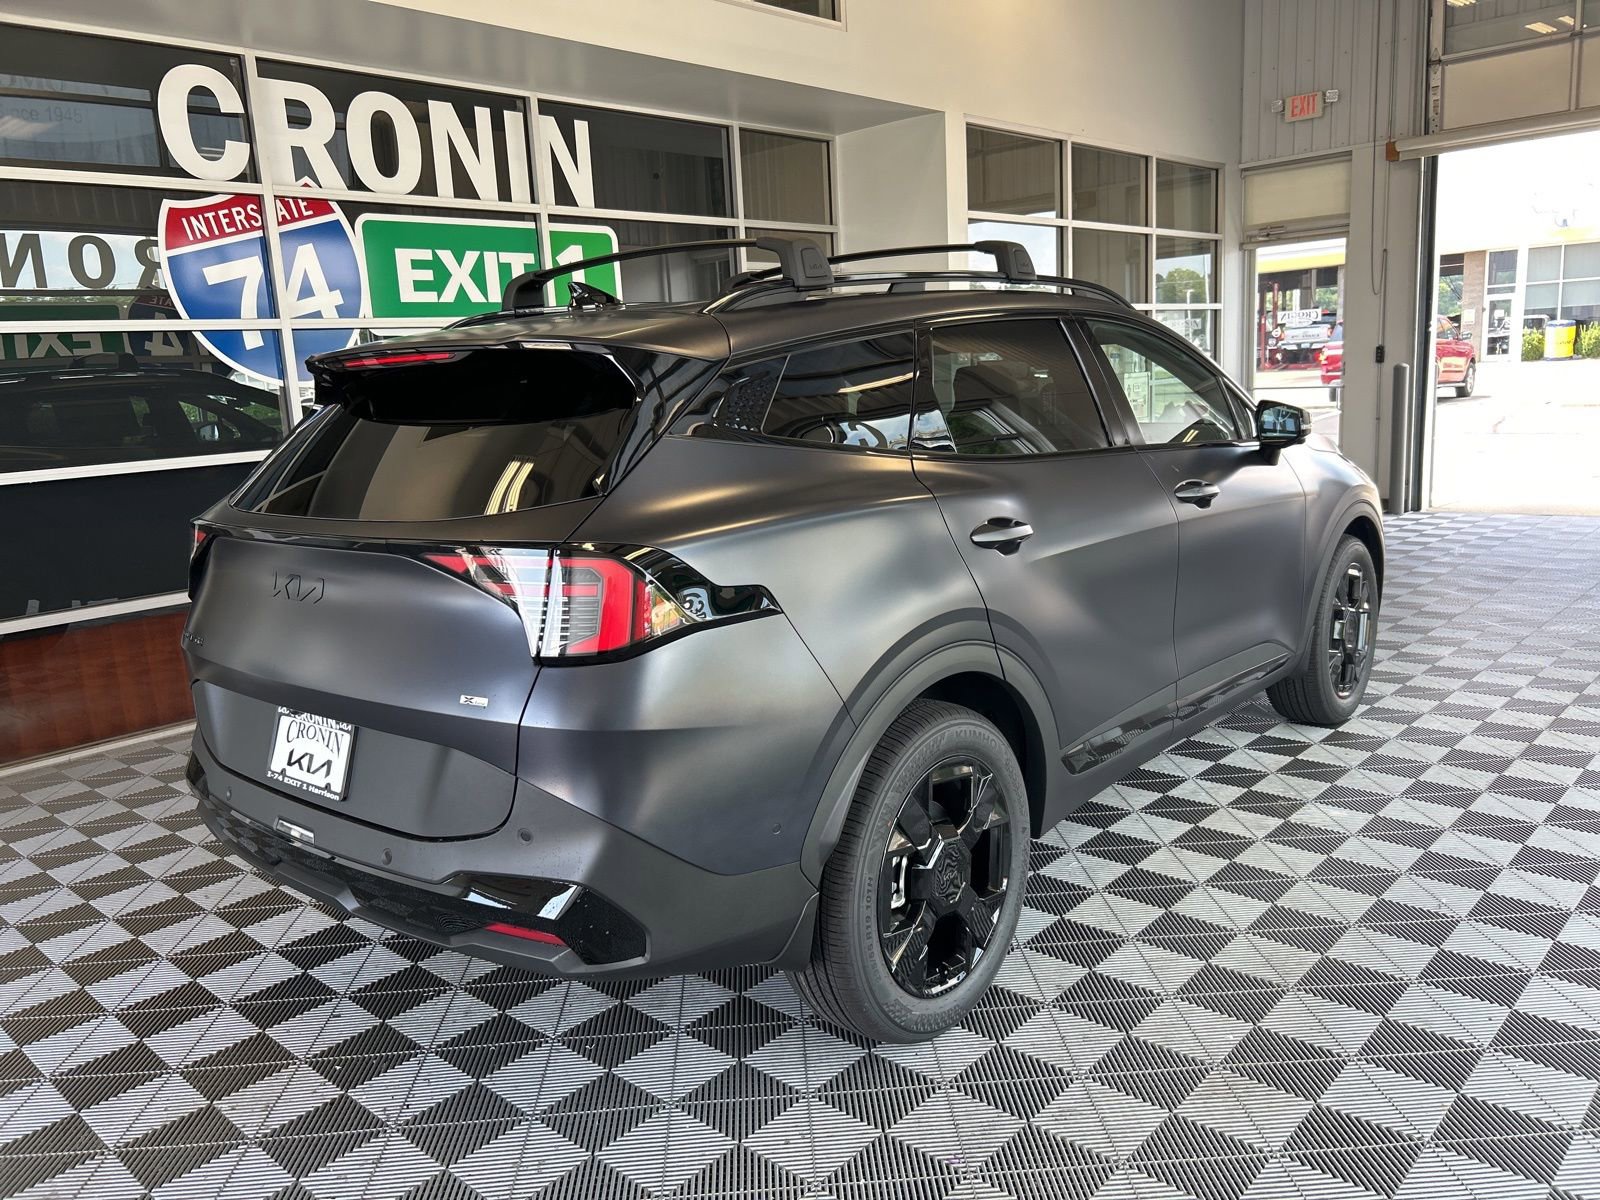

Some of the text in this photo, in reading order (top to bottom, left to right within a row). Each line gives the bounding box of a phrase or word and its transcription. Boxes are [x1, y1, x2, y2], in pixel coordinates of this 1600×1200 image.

[44, 105, 83, 124] 1945
[1291, 94, 1318, 117] EXIT
[157, 63, 596, 209] CRONIN
[181, 197, 315, 242] INTERSATE
[394, 244, 586, 303] EXIT 1
[202, 242, 344, 351] 74
[272, 570, 325, 605] KIA
[286, 719, 345, 759] CRONIN
[955, 728, 997, 747] KUMHO
[286, 747, 333, 779] KIA
[266, 770, 284, 782] I-74
[283, 777, 302, 788] EXIT
[308, 786, 341, 802] Harrison
